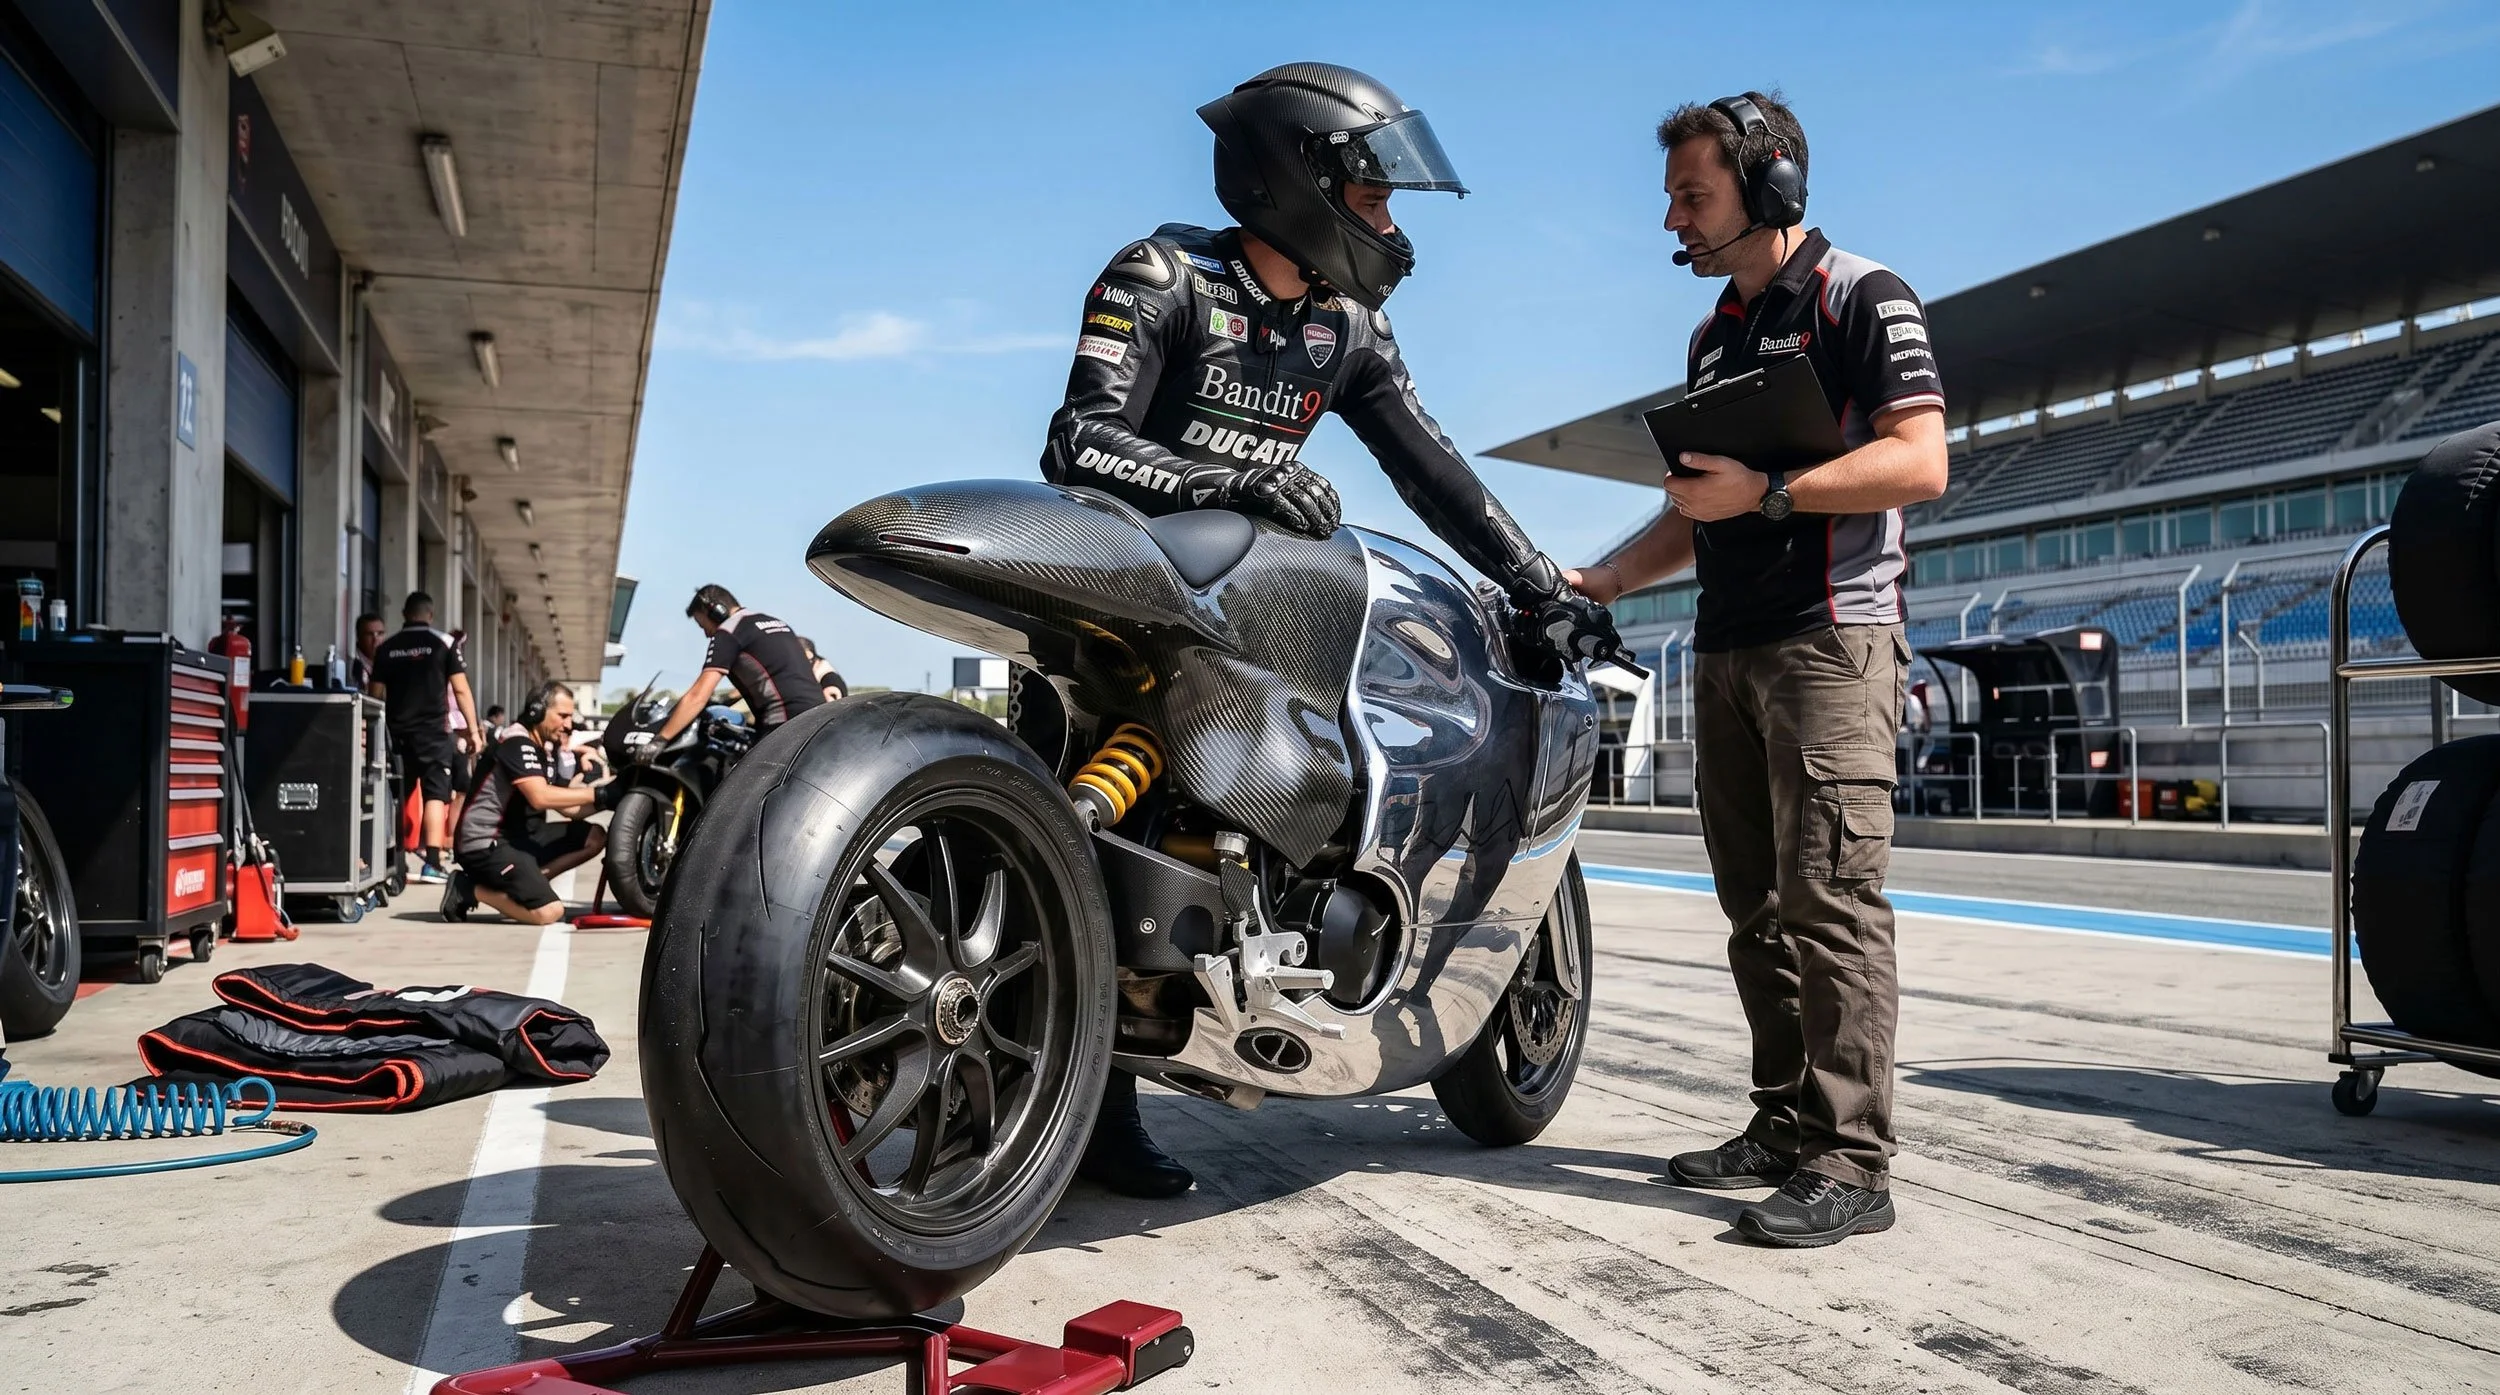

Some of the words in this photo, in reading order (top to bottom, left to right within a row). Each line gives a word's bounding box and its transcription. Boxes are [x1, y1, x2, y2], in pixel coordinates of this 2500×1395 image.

[1759, 332, 1811, 352] Bandit9
[1195, 363, 1322, 423] Bandit9
[1180, 420, 1300, 466] DUCATI
[1076, 446, 1182, 494] DUCATI
